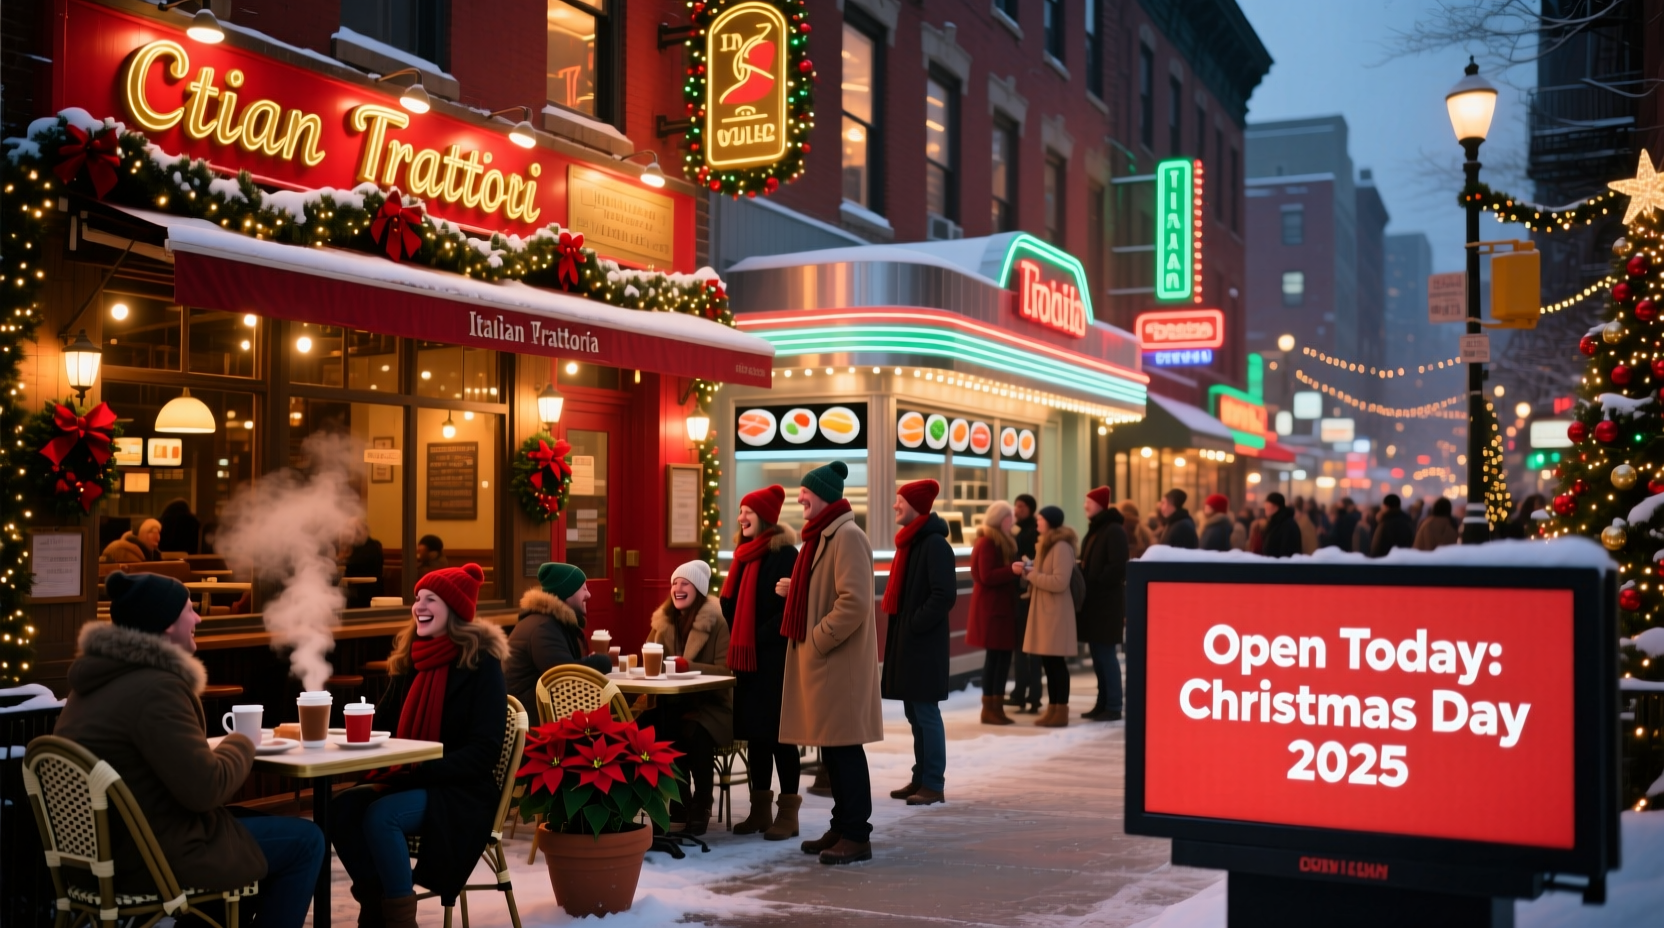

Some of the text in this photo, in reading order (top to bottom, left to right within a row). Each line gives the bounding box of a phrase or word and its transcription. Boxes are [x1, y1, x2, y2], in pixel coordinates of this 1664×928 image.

[126, 39, 326, 167] Ctian
[469, 310, 525, 343] Italian
[1203, 623, 1504, 687] Open Today:
[1179, 677, 1532, 750] Christmas Day
[1286, 738, 1410, 788] 2025
